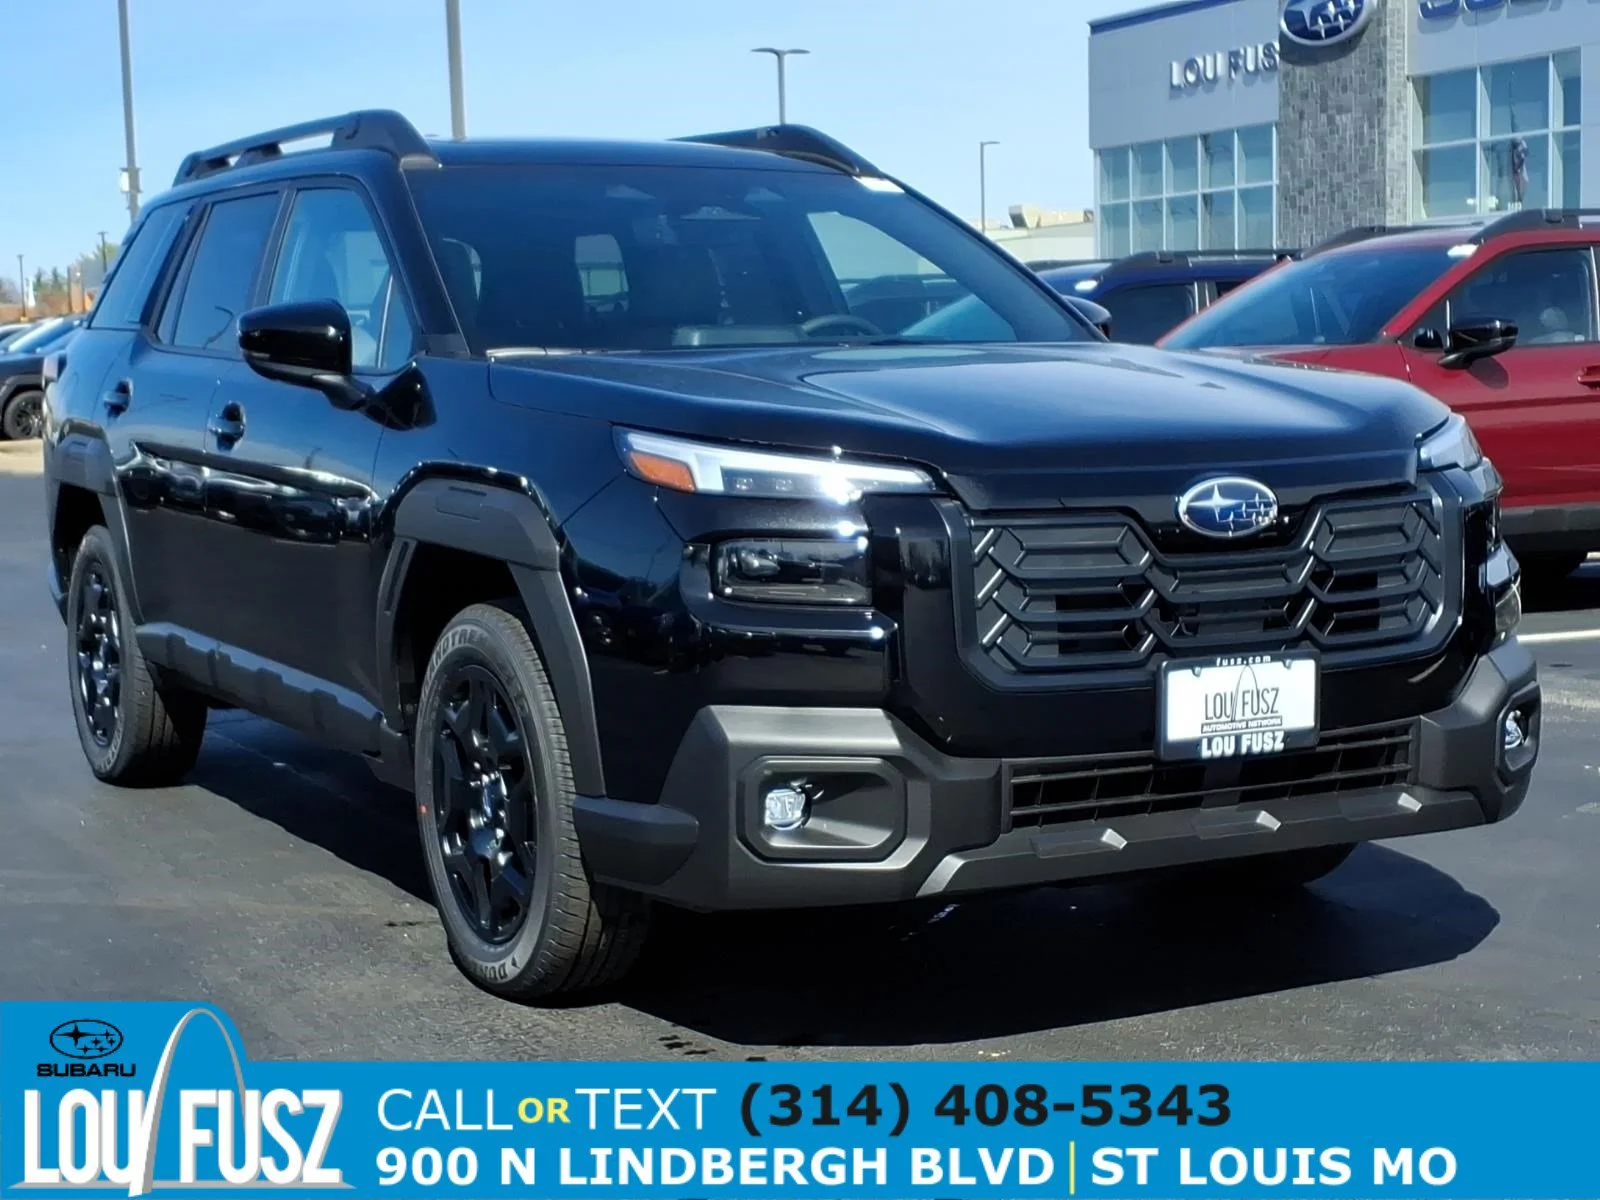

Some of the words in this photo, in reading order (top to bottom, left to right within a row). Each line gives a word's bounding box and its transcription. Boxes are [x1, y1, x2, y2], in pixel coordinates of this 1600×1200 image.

[1169, 51, 1224, 88] LOU
[1228, 41, 1280, 80] FUS
[1216, 655, 1271, 667] fusz.com
[1205, 690, 1234, 720] LOU
[1242, 687, 1280, 717] FUSZ
[1201, 735, 1236, 760] LOU
[1241, 730, 1285, 756] FUSZ
